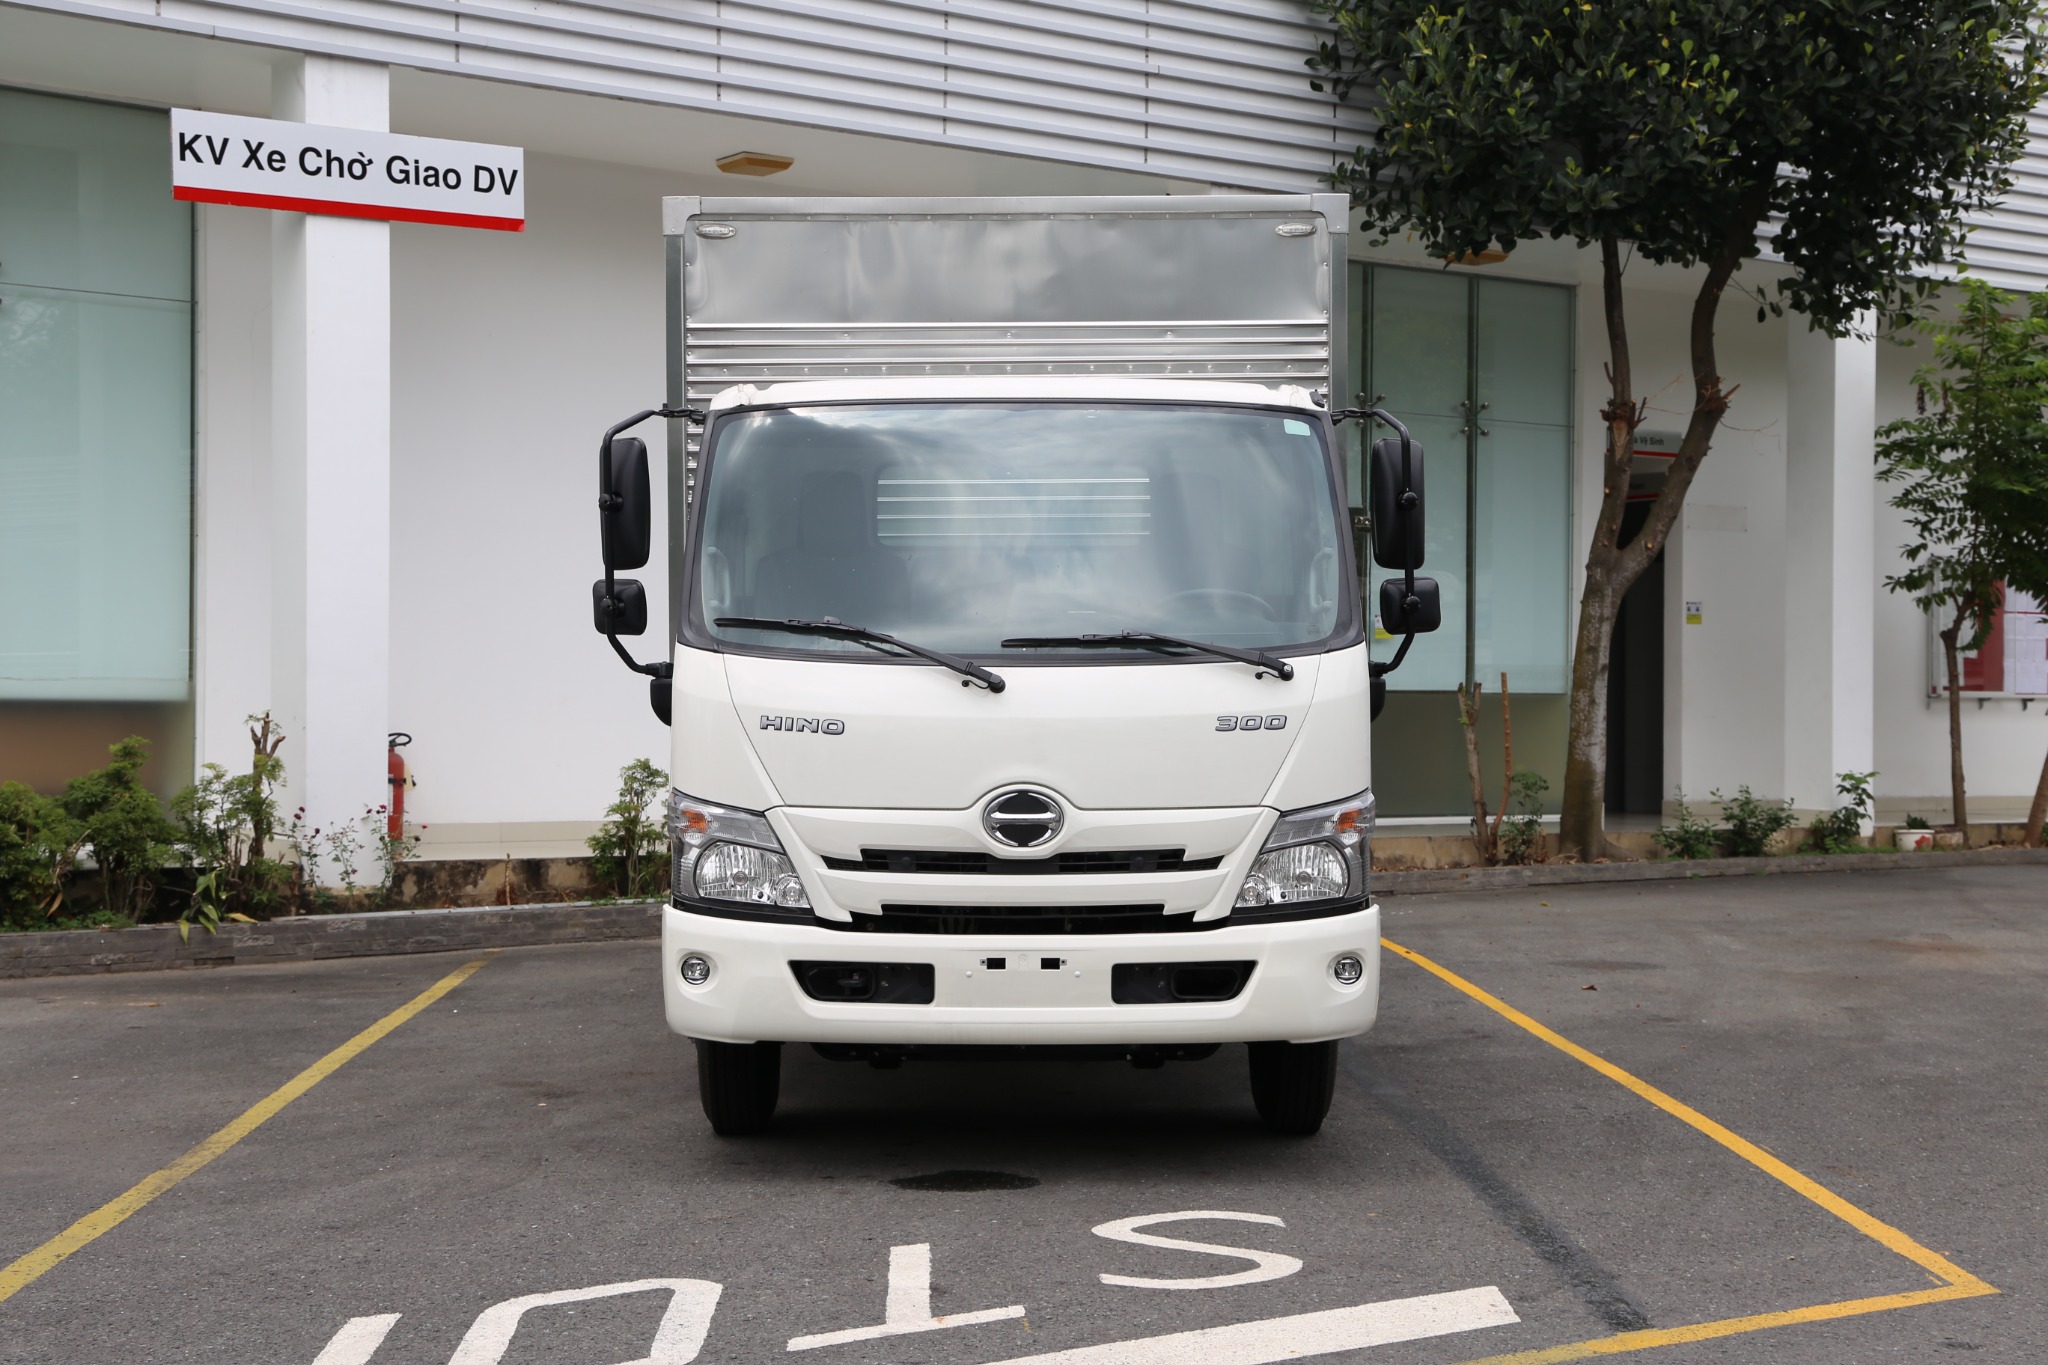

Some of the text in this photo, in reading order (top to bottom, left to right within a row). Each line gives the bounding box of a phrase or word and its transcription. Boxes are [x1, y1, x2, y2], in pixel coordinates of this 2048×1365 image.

[179, 132, 519, 196] KV Xe Chờ Giao DV
[760, 715, 845, 735] HINO
[1215, 715, 1287, 732] 300
